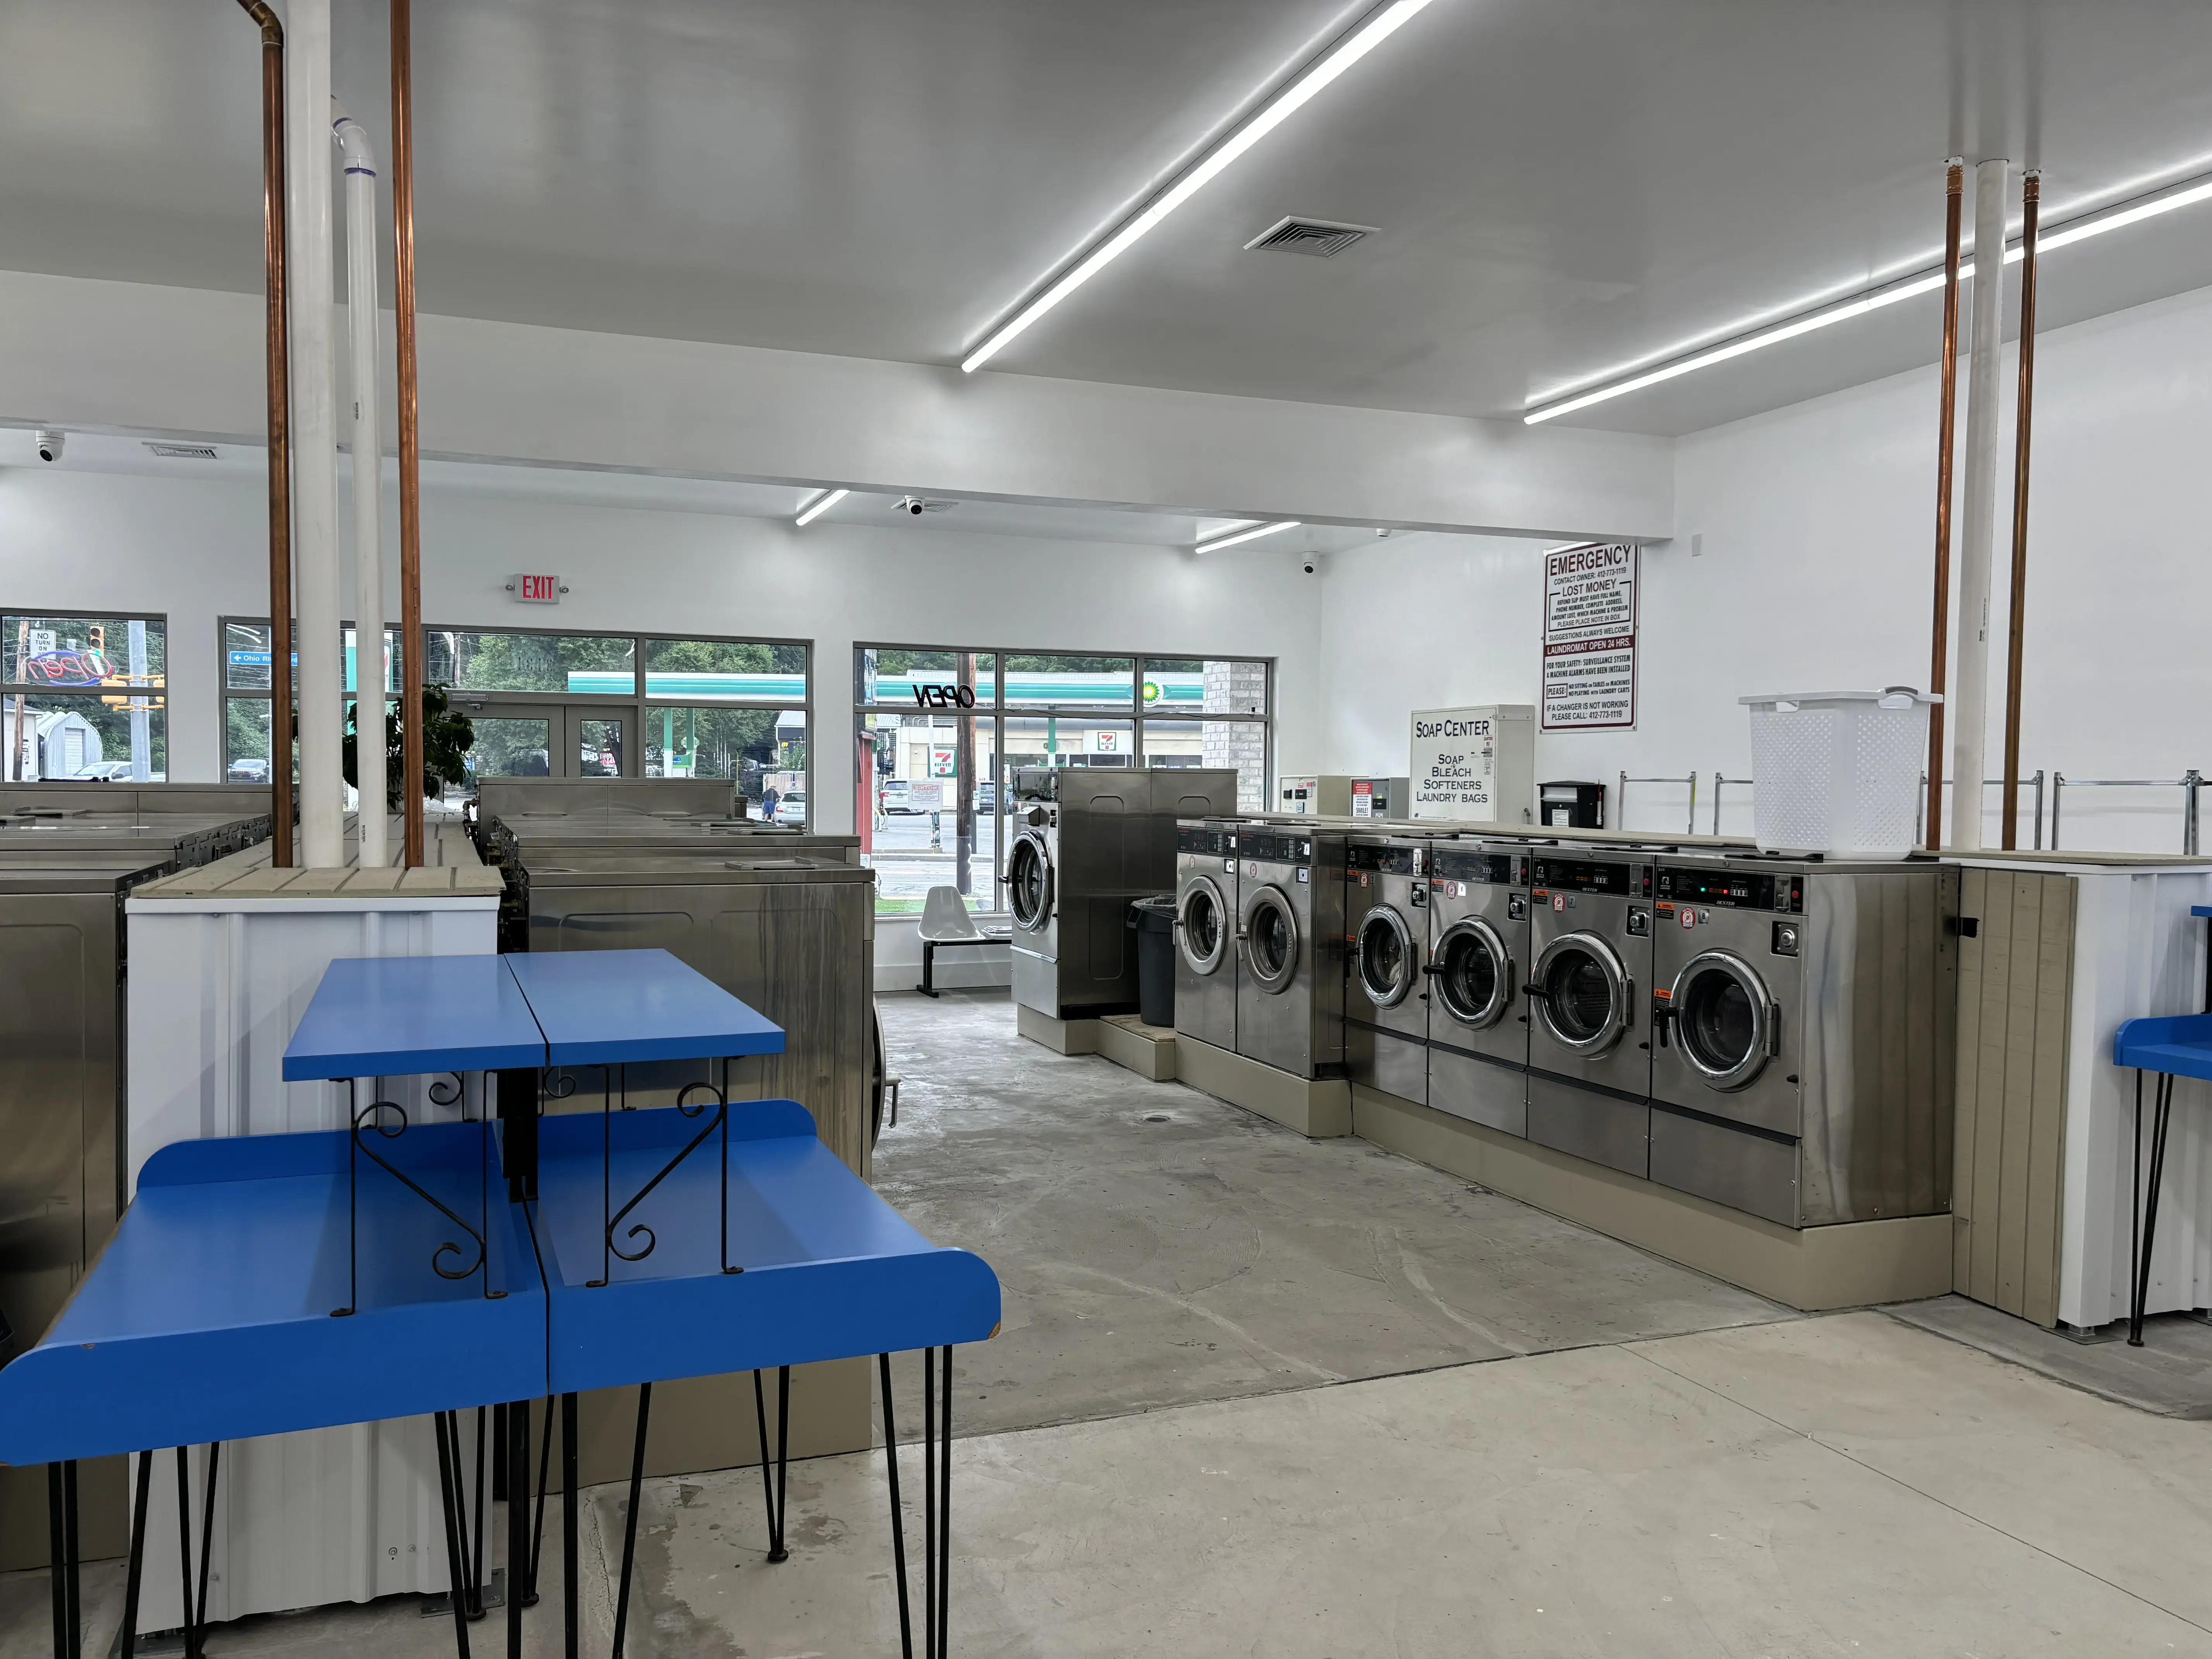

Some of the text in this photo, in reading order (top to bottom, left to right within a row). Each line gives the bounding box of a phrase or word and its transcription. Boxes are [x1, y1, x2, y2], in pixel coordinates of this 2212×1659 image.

[1550, 545, 1631, 576] EMERGENCY
[1554, 567, 1626, 585] CONTACT OWNER: 412-773-1119
[523, 575, 554, 599] EXIT
[1563, 578, 1617, 597] LOST MONEY
[1549, 625, 1630, 641] SUGGESTIONS ALWAYS WELCOME
[1547, 637, 1631, 654] LAUNDROMAT OPEN 24 HRS.
[1583, 656, 1613, 666] SURVEILLANCE
[1614, 654, 1630, 663] SYSTEM
[1608, 665, 1630, 673] INSTALLED
[1601, 700, 1628, 709] WORKING
[1589, 710, 1622, 719] 412-773-1119
[1462, 794, 1487, 803] BAGS
